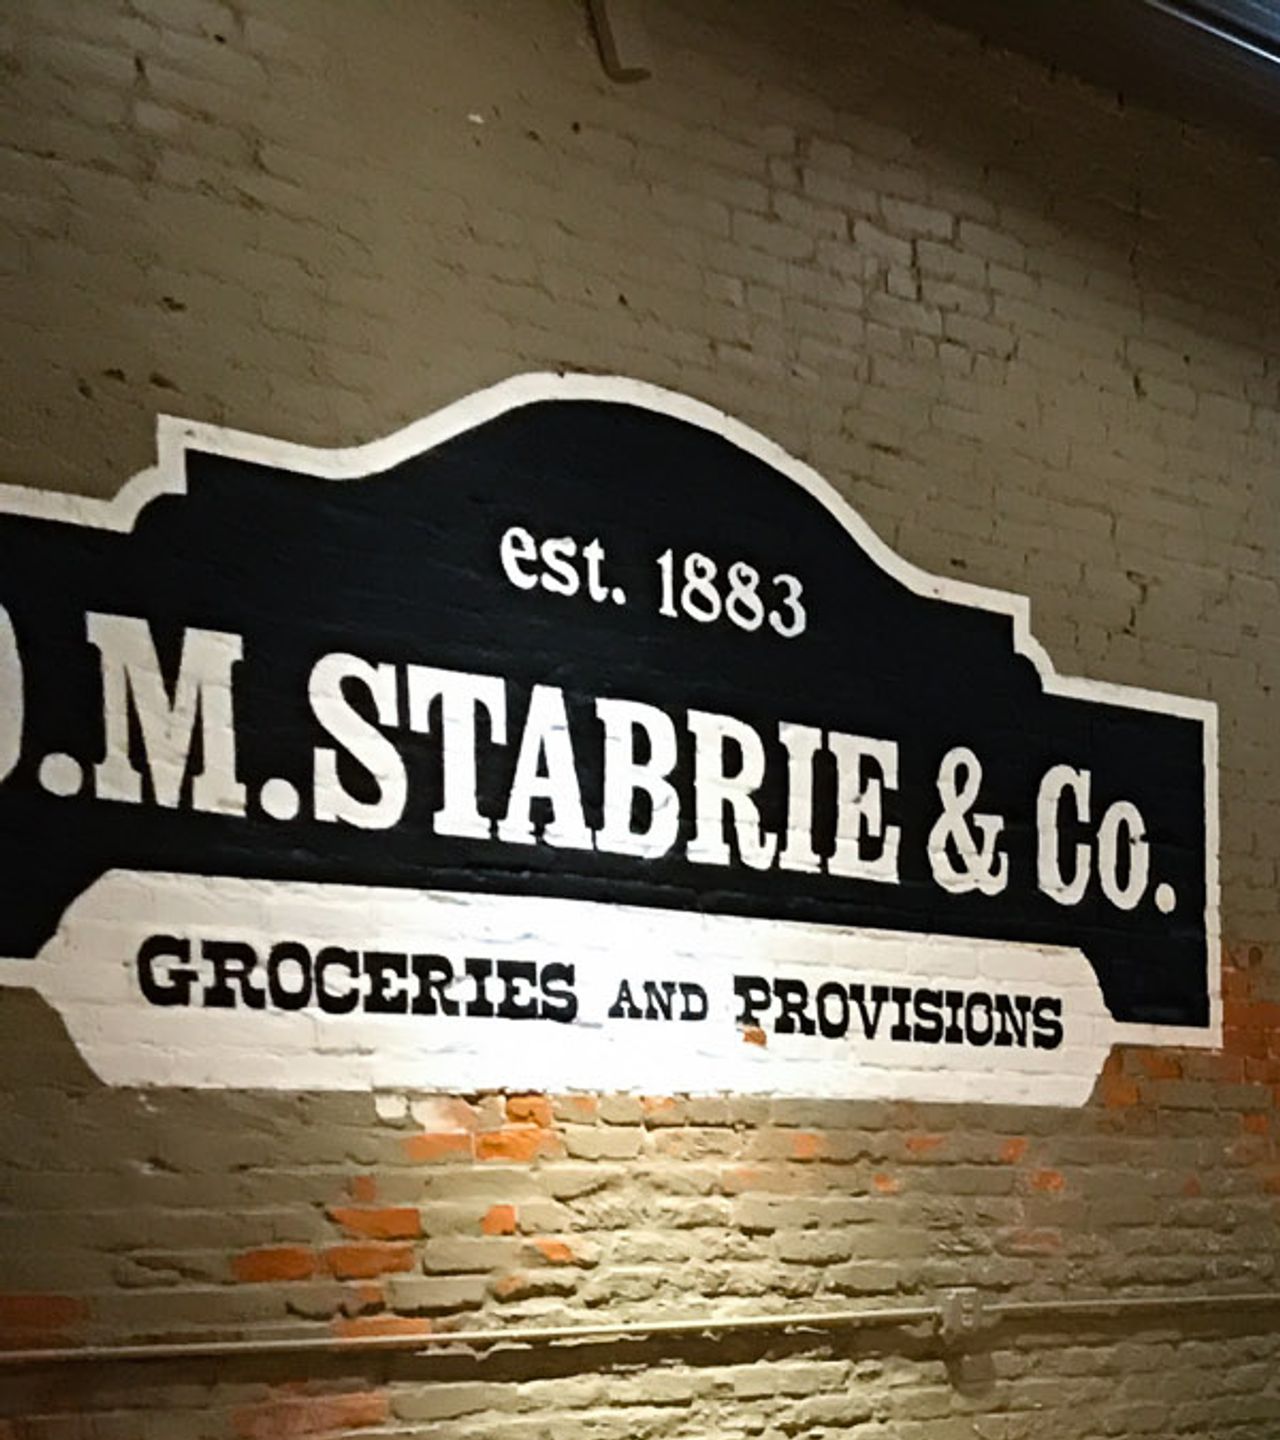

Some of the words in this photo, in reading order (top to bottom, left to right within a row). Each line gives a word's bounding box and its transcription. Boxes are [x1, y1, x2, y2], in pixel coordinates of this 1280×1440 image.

[500, 526, 627, 605] est.
[656, 548, 806, 638] 1883
[926, 746, 1009, 896] &
[136, 934, 578, 1023] GROCERIES
[608, 979, 708, 1021] AND
[733, 975, 1064, 1050] PROVISIONS
